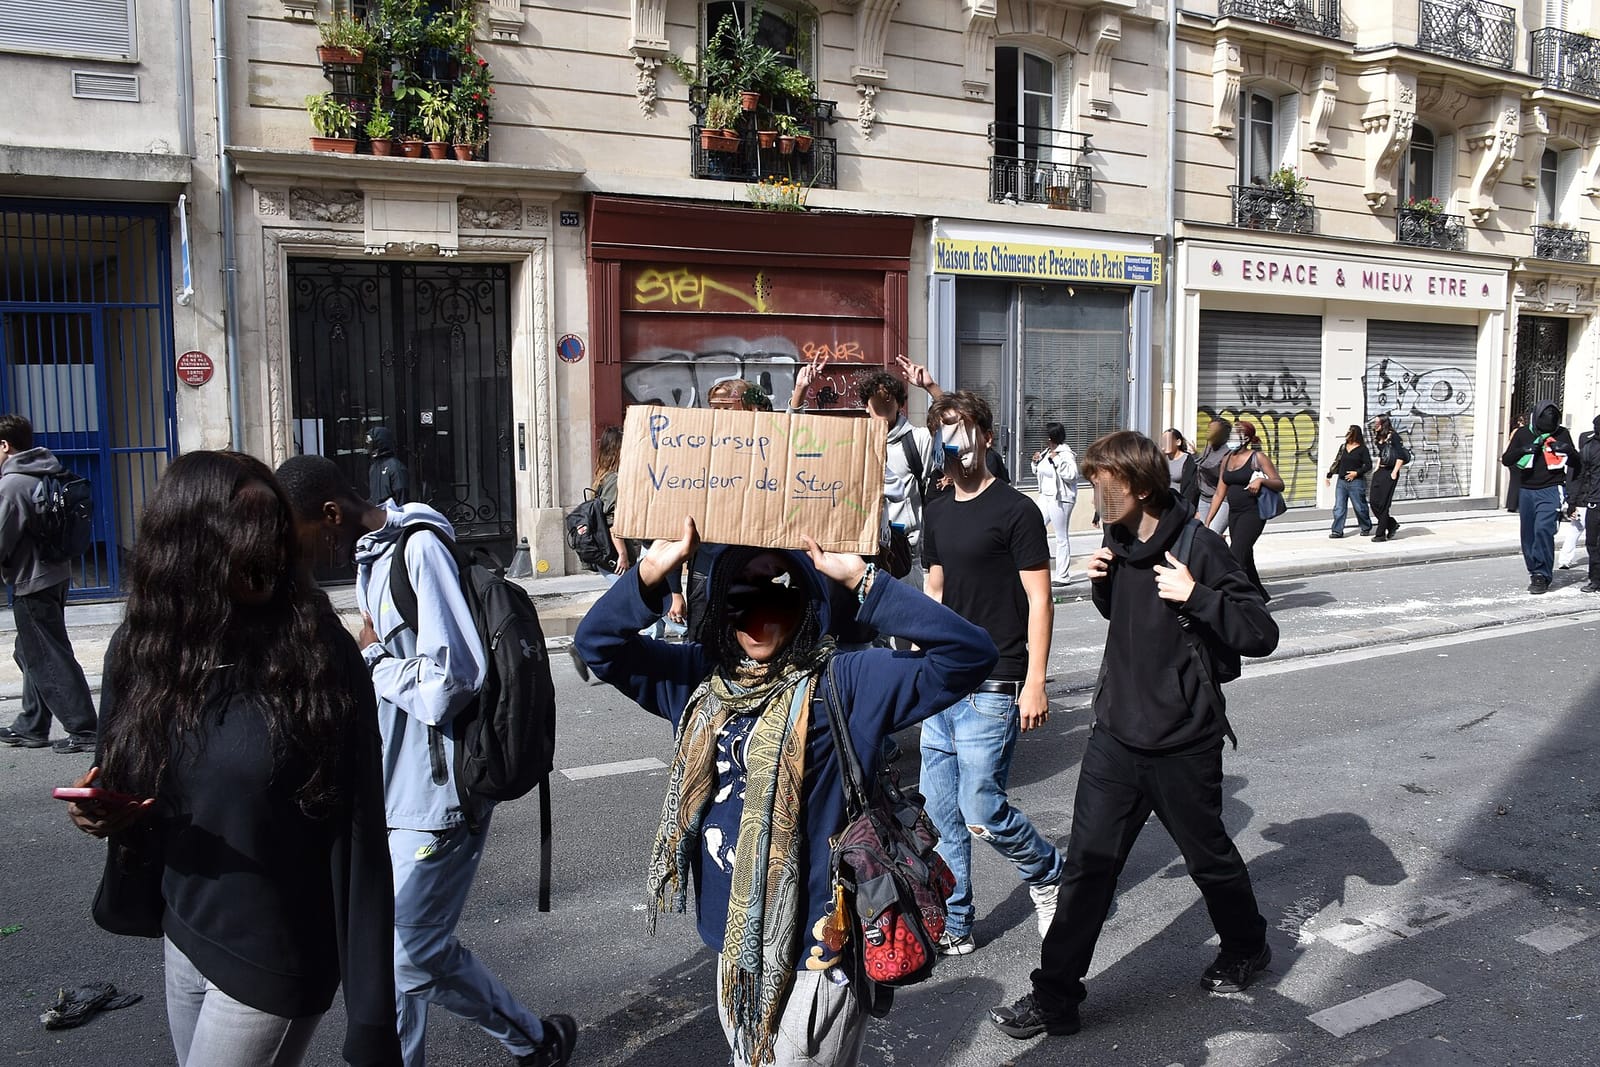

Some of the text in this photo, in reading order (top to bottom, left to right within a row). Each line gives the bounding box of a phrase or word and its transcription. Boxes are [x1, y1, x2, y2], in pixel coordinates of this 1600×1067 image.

[937, 242, 1122, 279] Maison des Chômeurs et Précaires de Paris
[1242, 260, 1467, 297] ESPACE & MIEUX ETRE
[649, 414, 770, 460] Parcoursup
[647, 463, 844, 507] Vendeur de Stup
